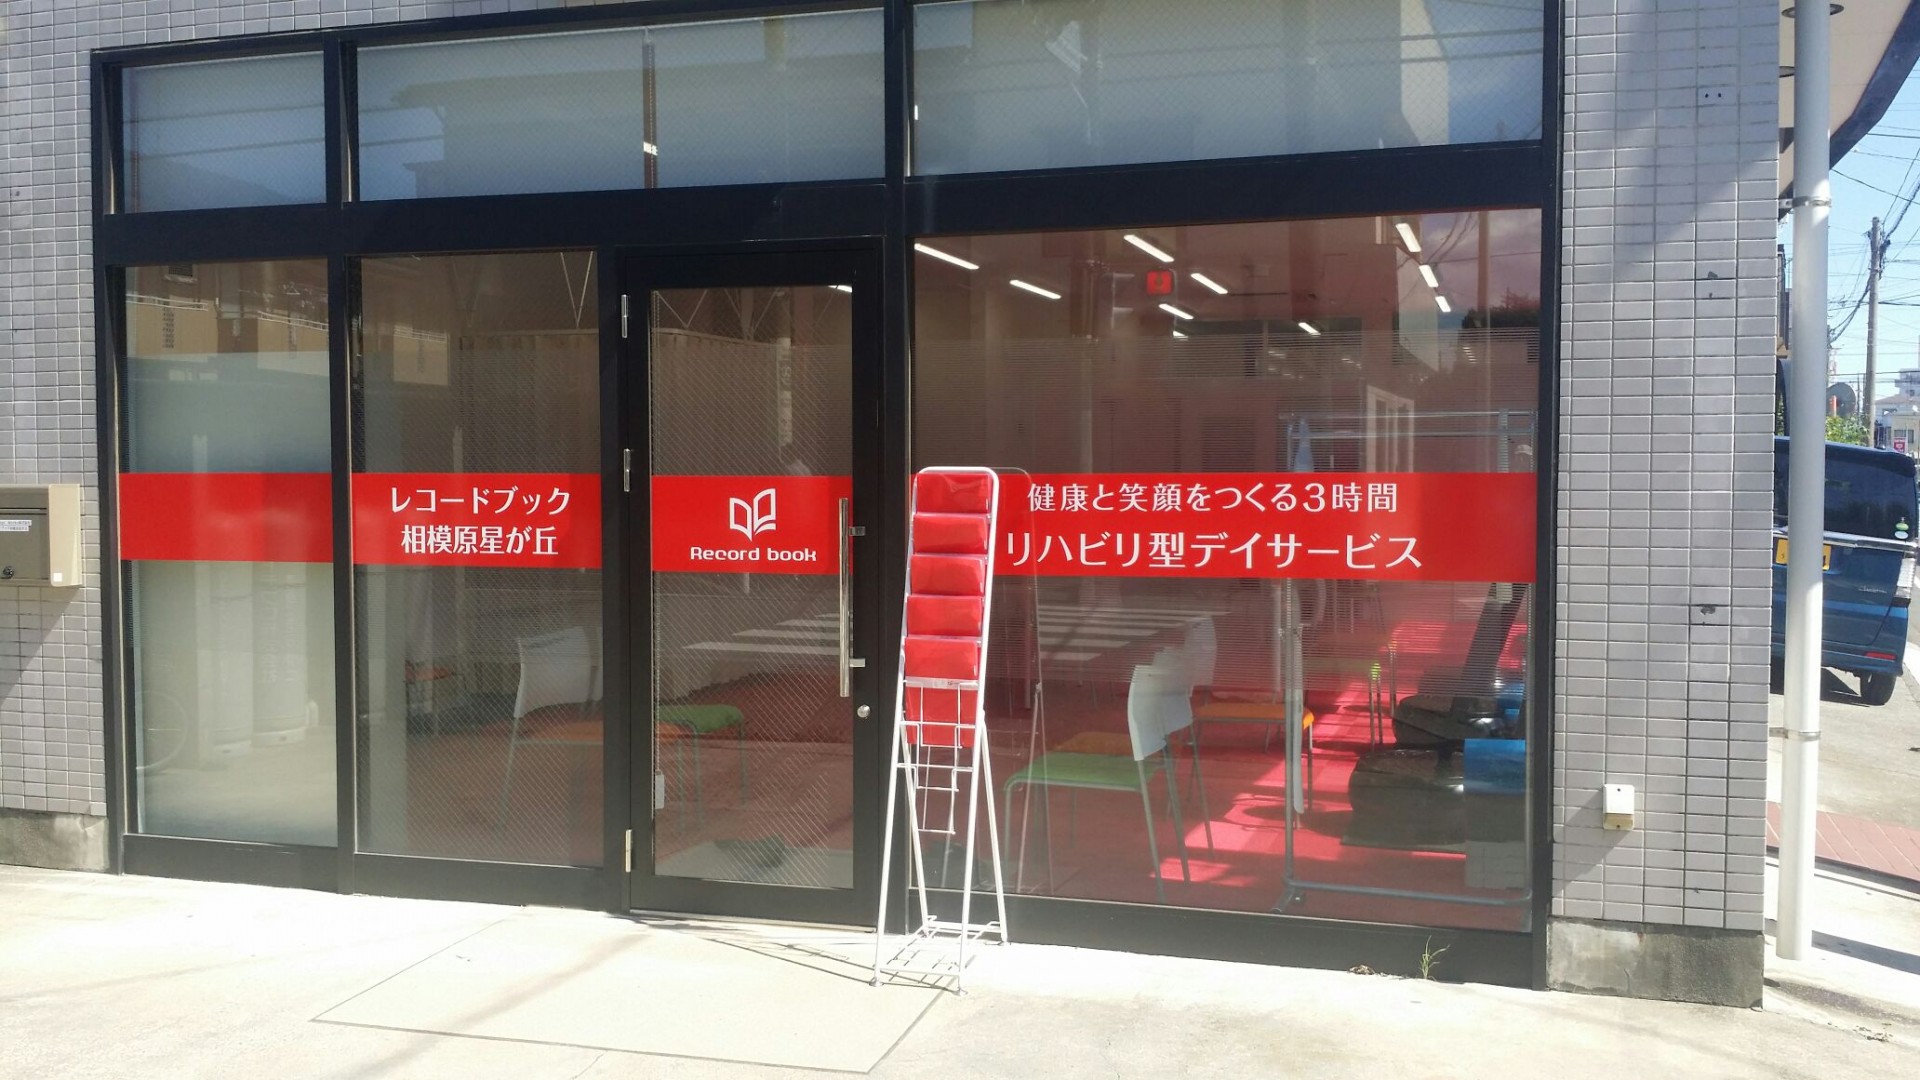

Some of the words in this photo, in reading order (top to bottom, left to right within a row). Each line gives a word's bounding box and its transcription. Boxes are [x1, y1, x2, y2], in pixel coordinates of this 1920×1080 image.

[391, 486, 570, 515] レコードブック
[1027, 482, 1397, 513] 健康と笑顔をつくる3時間
[400, 524, 559, 556] 相模原星が丘
[690, 546, 760, 561] Record
[767, 547, 817, 562] book
[1006, 531, 1423, 570] リハビリ型デイサービス
